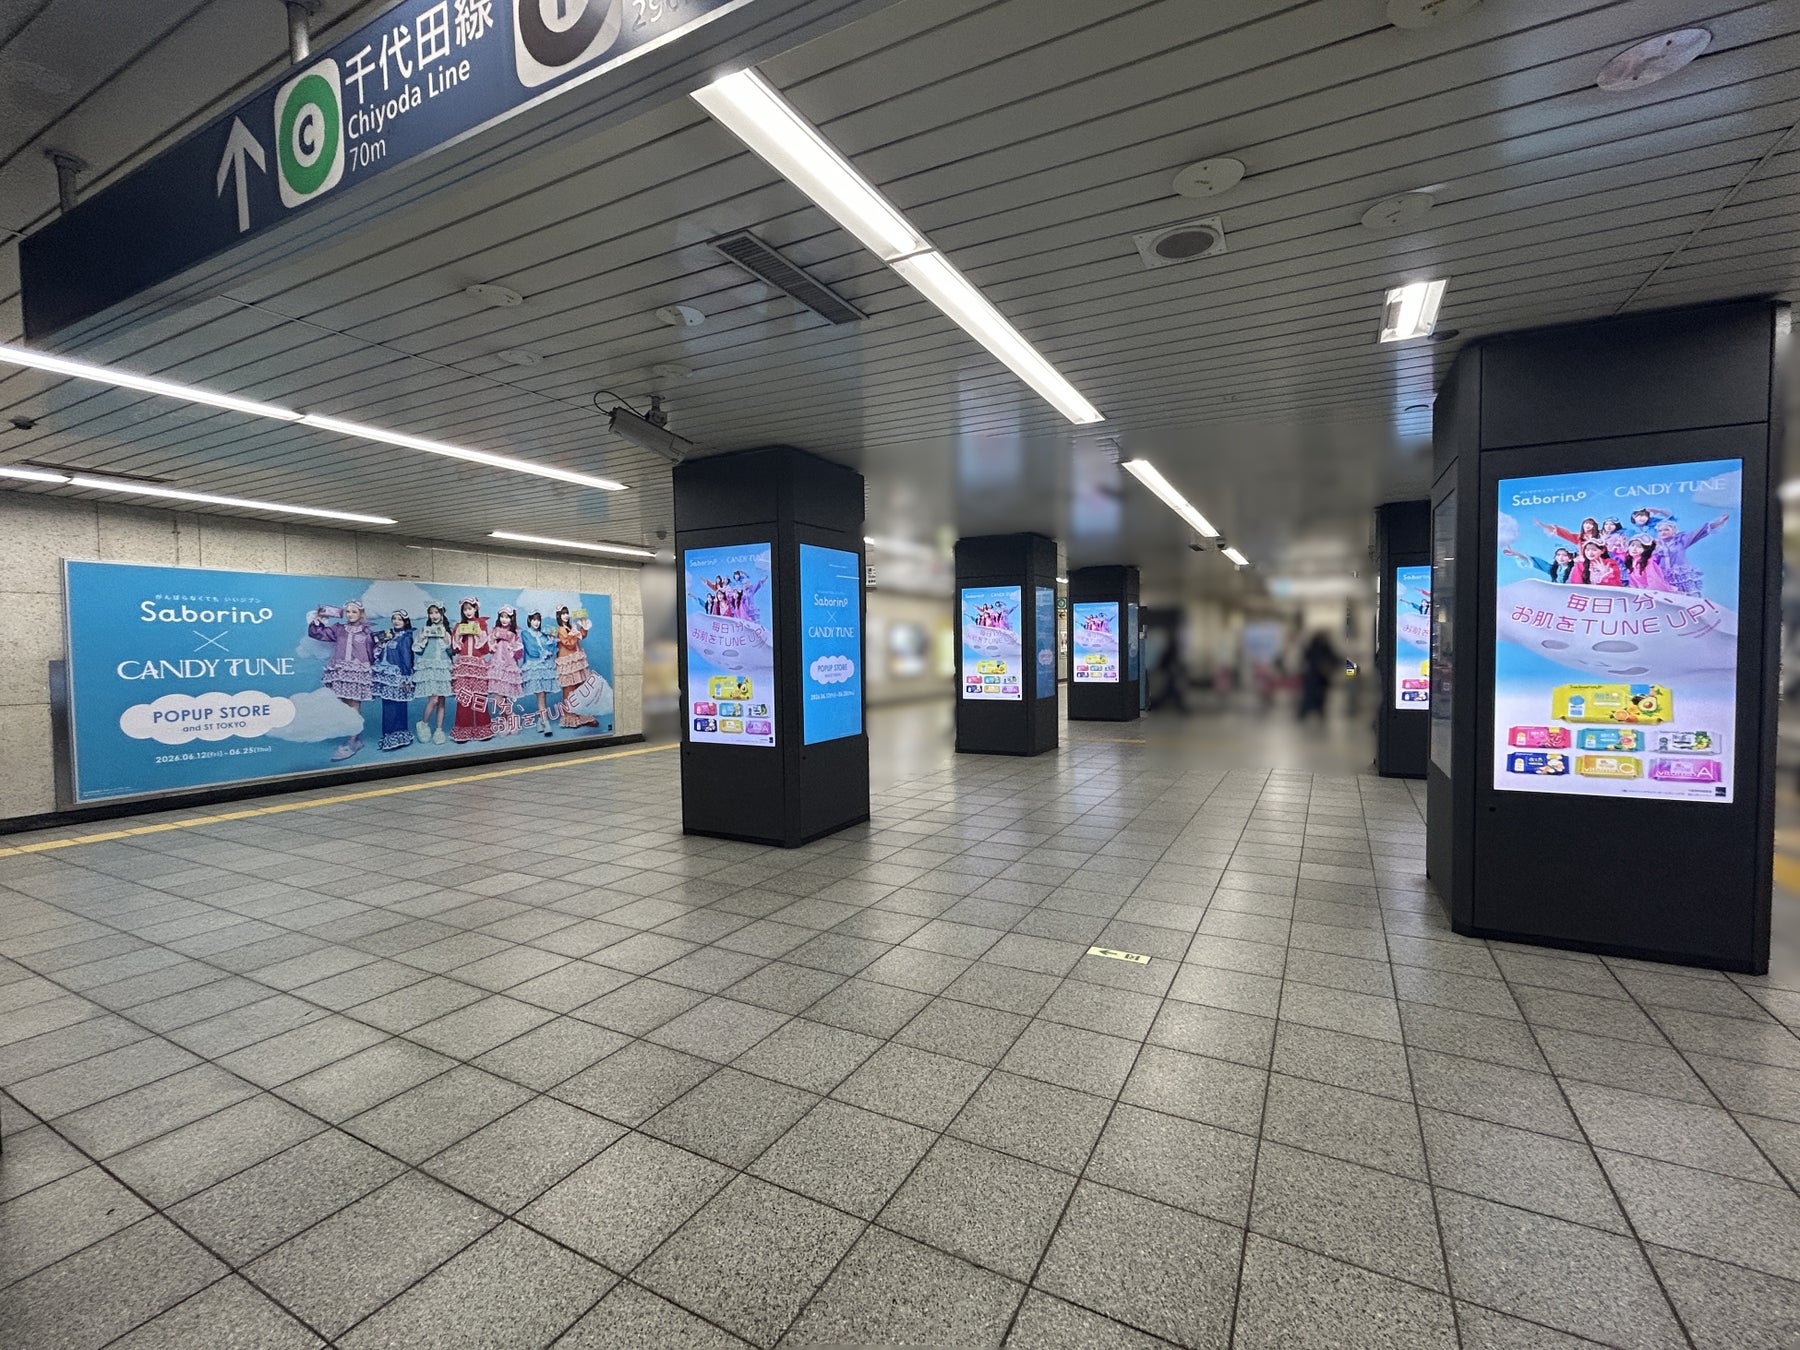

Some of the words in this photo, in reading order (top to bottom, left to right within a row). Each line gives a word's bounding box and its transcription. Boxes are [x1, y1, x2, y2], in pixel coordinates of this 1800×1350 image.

[345, 0, 494, 104] 千代田線
[348, 84, 422, 139] Chiyoda
[428, 59, 471, 98] Line
[298, 114, 315, 156] C
[349, 138, 386, 172] 70m
[1511, 490, 1587, 507] Saborino
[1614, 482, 1673, 498] CANDY
[1677, 478, 1727, 493] TUNE
[140, 600, 273, 624] Saborino
[813, 593, 849, 608] Saborino
[1666, 598, 1719, 629] UP!
[808, 626, 835, 638] CANDY
[116, 658, 220, 680] CANDY
[224, 657, 295, 677] TUNE
[153, 708, 214, 724] POPUP
[220, 704, 271, 719] STORE
[182, 724, 201, 733] and
[204, 723, 214, 731] ST
[216, 720, 247, 730] TOKYO
